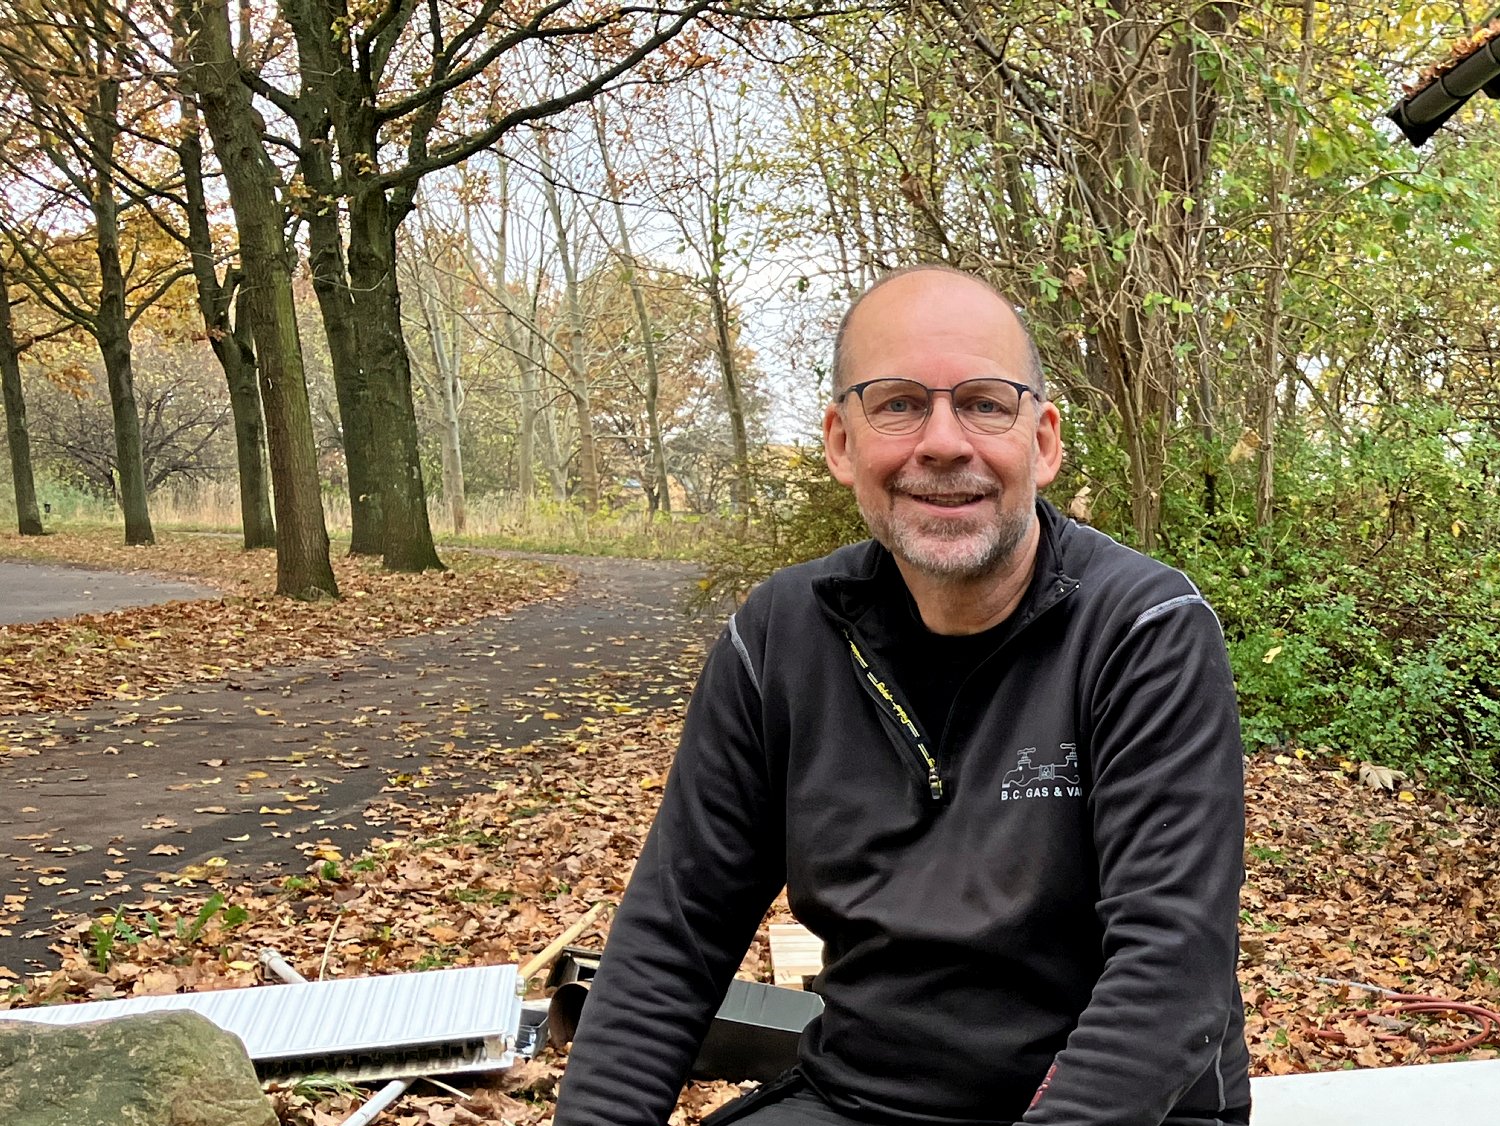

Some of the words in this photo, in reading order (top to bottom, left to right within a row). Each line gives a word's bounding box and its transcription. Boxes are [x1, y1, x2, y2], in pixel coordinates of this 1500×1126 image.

[1001, 789, 1022, 800] B.C.
[1025, 787, 1049, 798] GAS
[1053, 786, 1062, 797] &
